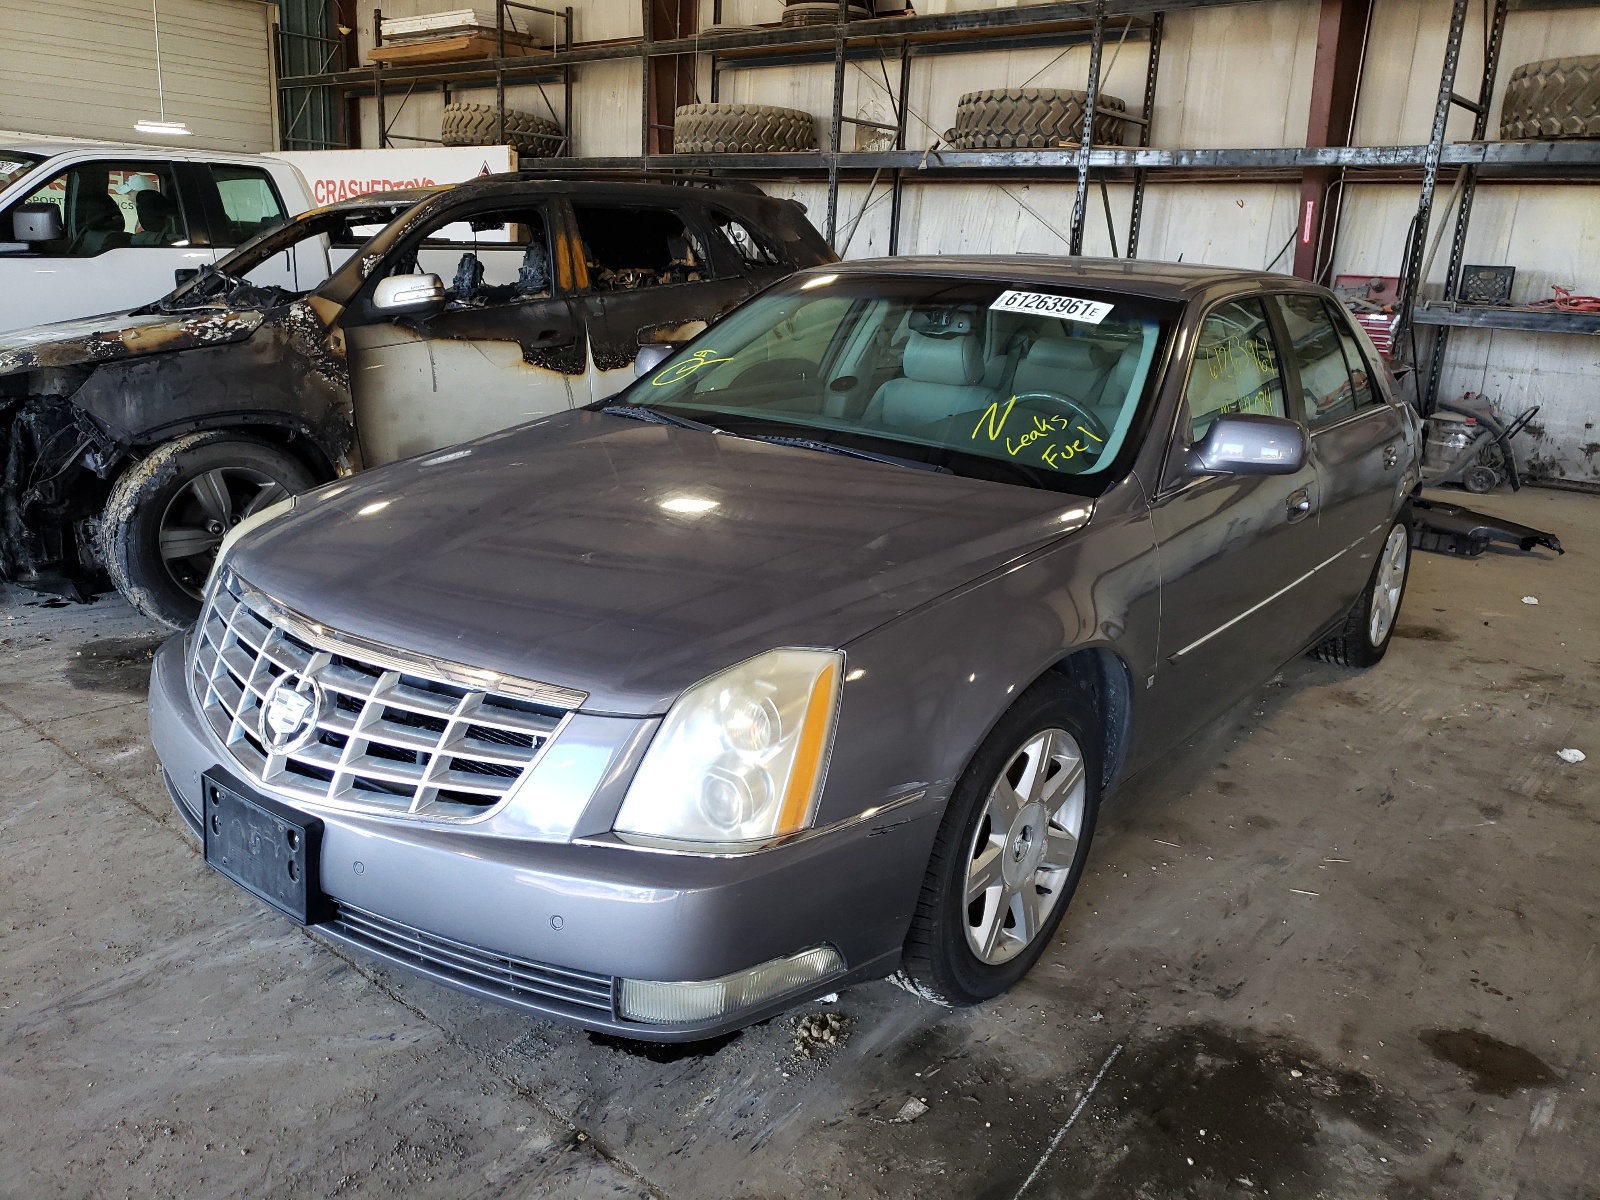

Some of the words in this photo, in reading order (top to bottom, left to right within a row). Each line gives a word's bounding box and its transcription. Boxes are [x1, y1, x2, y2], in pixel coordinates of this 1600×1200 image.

[1004, 292, 1093, 317] 61263961
[971, 394, 1017, 441] N
[1006, 414, 1069, 456] Leaks
[1041, 425, 1103, 470] Fuel
